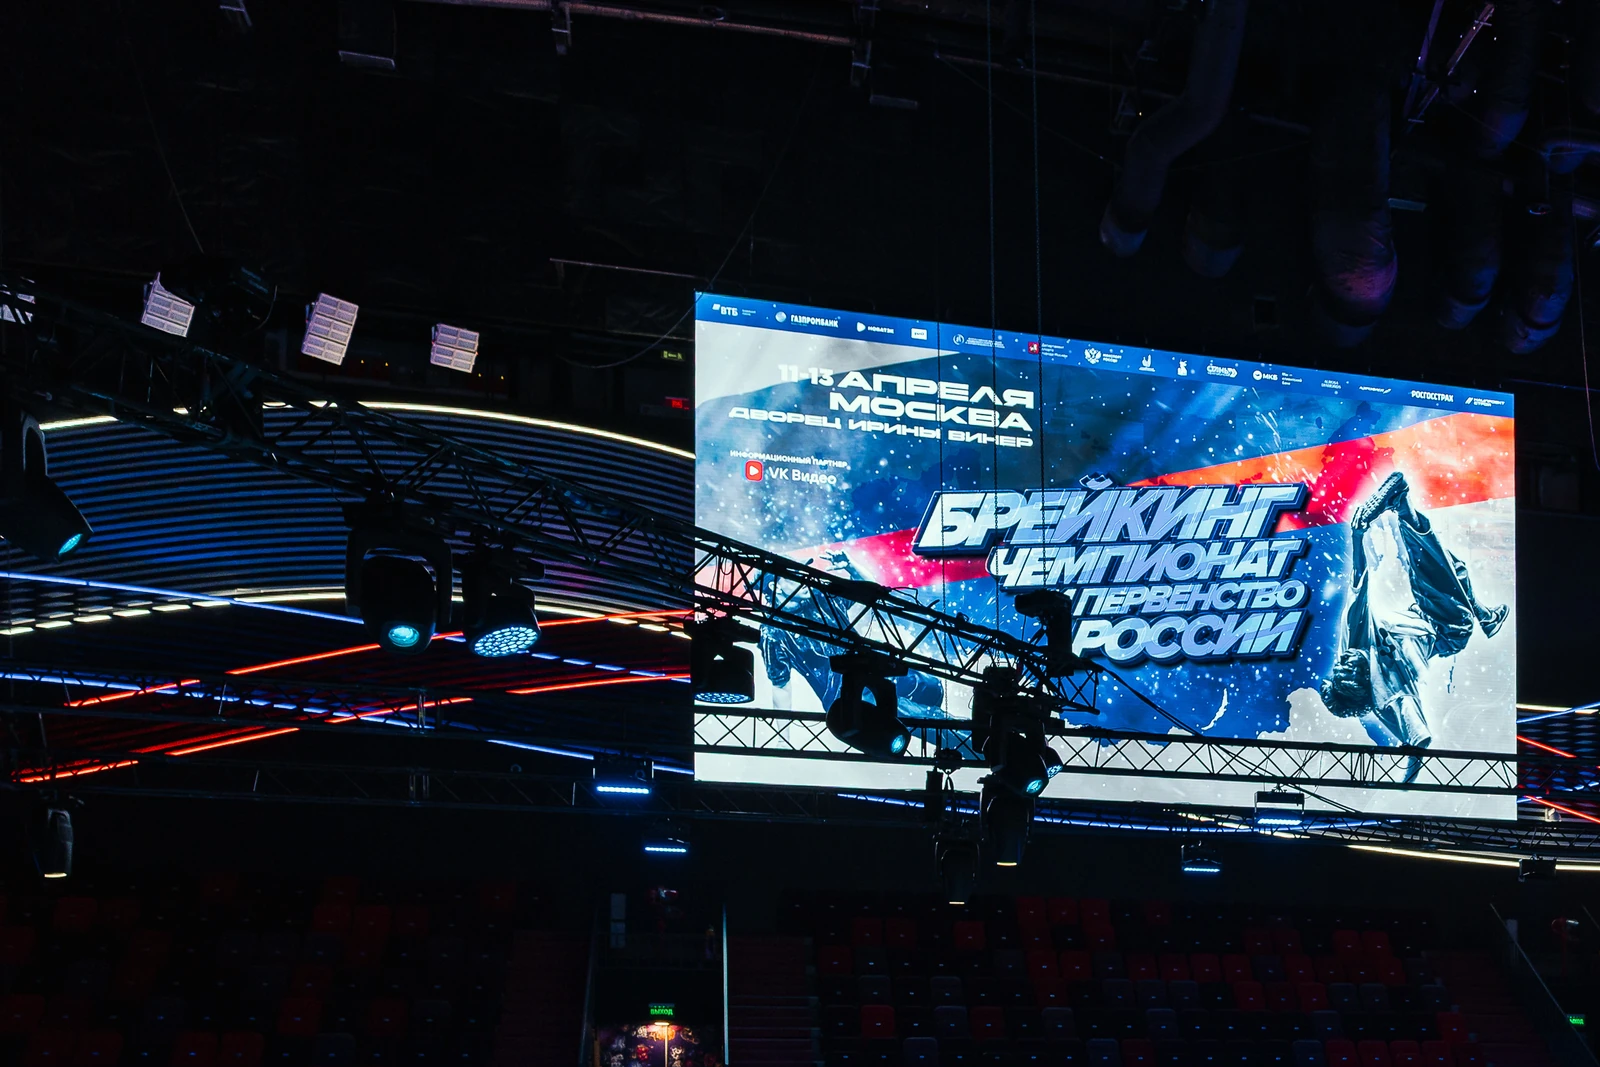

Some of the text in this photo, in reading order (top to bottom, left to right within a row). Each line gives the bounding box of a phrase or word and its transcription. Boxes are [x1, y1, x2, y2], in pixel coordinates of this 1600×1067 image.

[720, 306, 739, 317] ВТБ
[790, 314, 839, 328] ГАЗПРОМБАНК
[778, 364, 1034, 410] 11-13 АПРЕЛЯ
[1411, 390, 1454, 403] РОСГОССТРАХ
[728, 407, 1034, 448] ДВОРЕЦ ИРИНЫ ВИНЕР
[829, 392, 1033, 432] МОСКВА
[768, 466, 838, 485] VK Видео
[914, 474, 1305, 550] БРЕЙКИНГ
[988, 537, 1305, 588] ЧЕМПИОНАТ
[1072, 579, 1307, 617] ПЕРВЕНСТВО
[1071, 611, 1304, 663] РОССИИ
